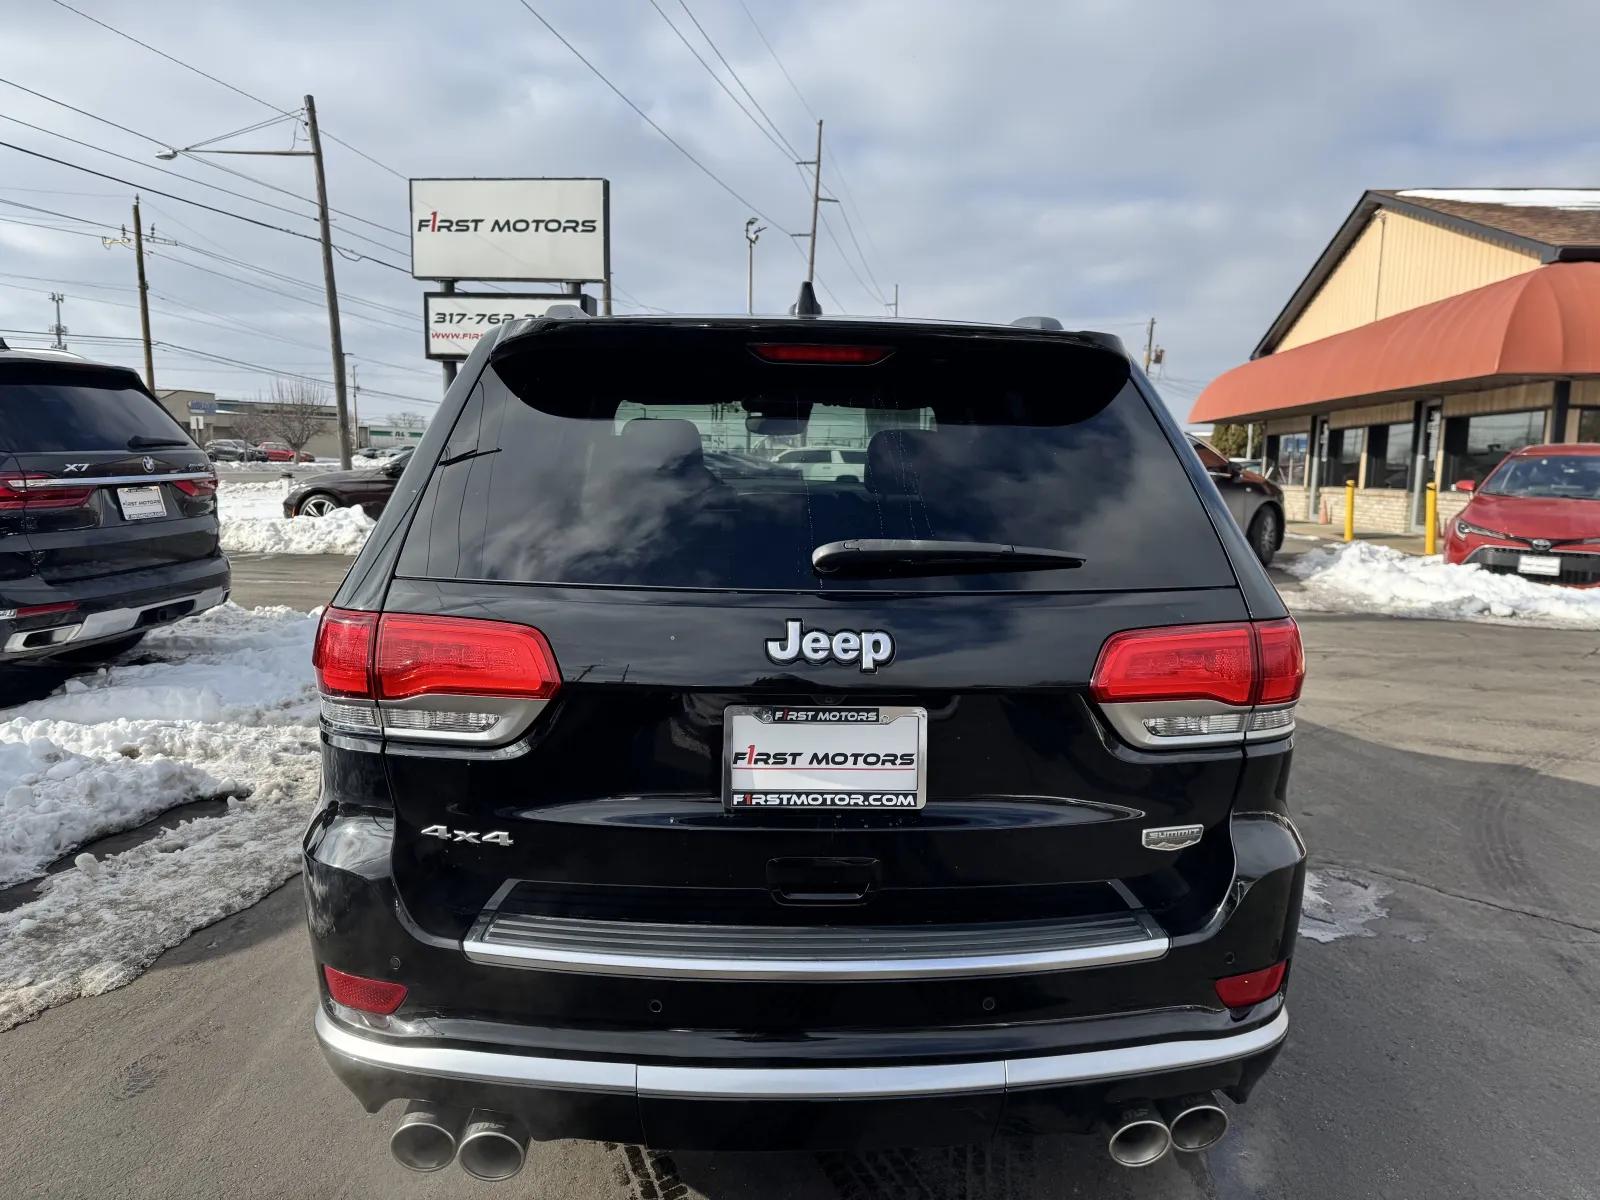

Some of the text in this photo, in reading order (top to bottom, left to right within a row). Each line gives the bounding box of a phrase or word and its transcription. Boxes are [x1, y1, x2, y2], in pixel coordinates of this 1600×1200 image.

[490, 219, 597, 233] MOTORS
[63, 463, 90, 472] X7
[766, 619, 895, 672] Jeep
[817, 711, 877, 721] MOTORS
[808, 752, 915, 766] MOTORS
[1149, 828, 1200, 839] SUMMIT
